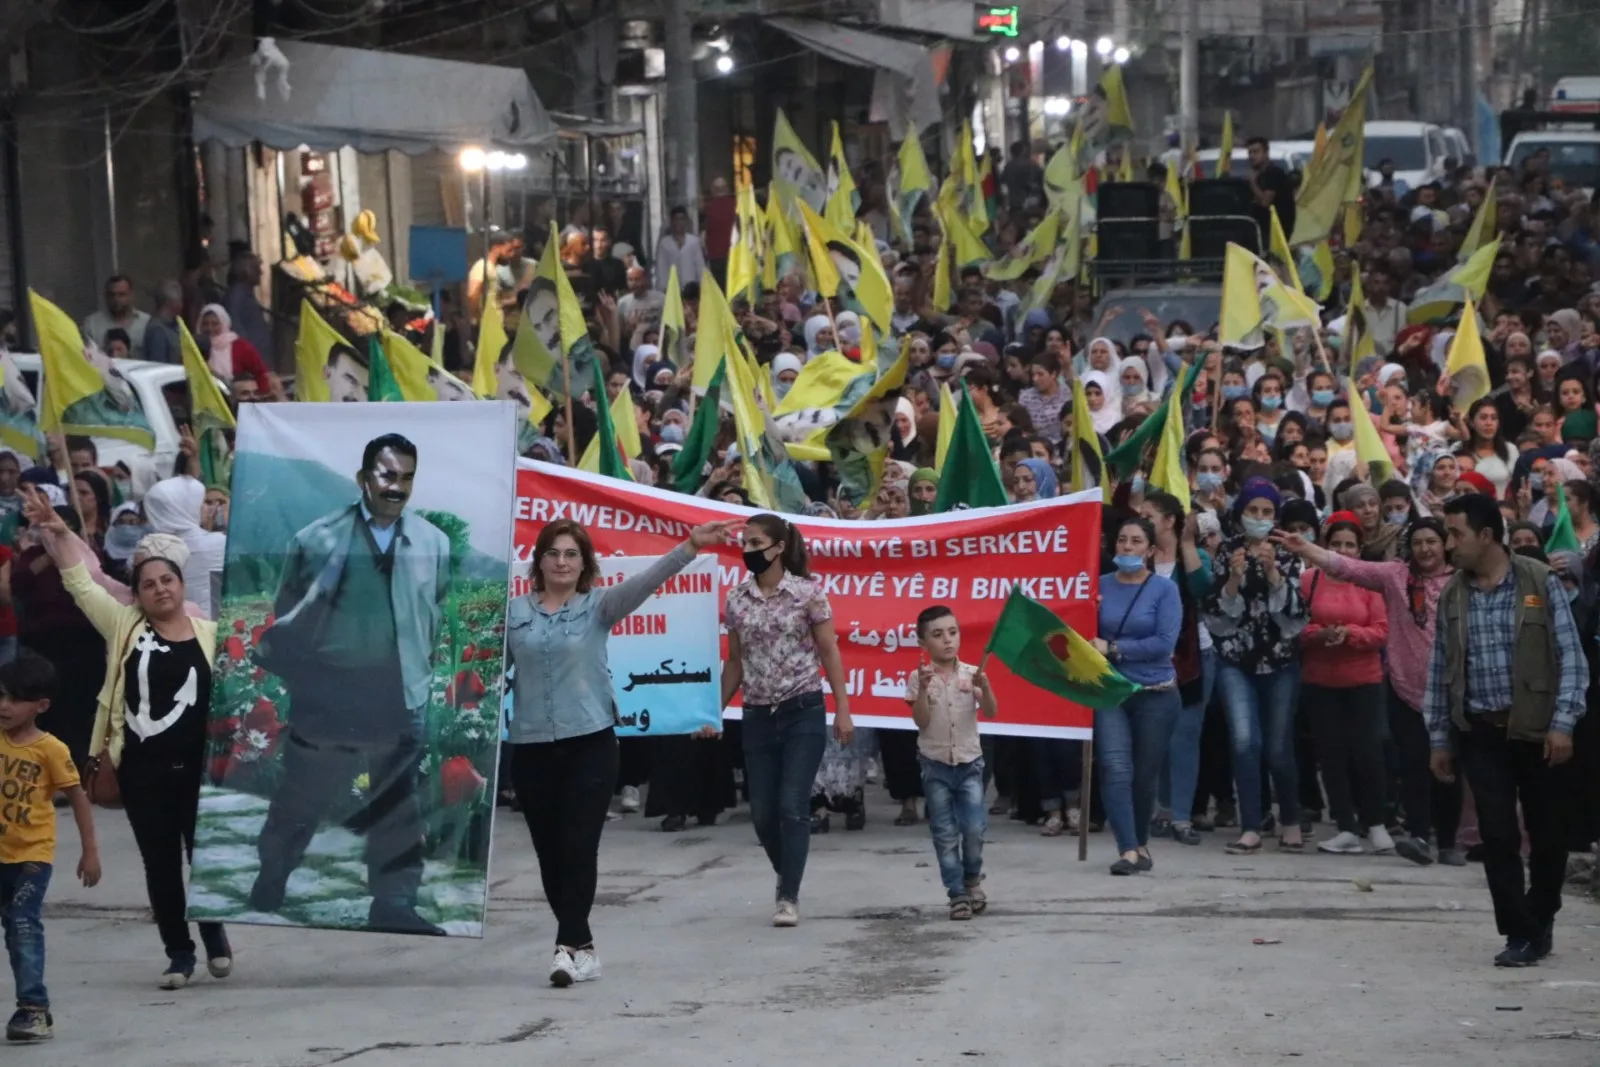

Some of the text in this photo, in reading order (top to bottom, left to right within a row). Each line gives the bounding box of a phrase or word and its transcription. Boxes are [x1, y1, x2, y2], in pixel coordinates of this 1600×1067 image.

[868, 536, 903, 558] YÊ
[911, 539, 937, 558] BI
[945, 525, 1068, 557] SERKEVÊ
[892, 573, 925, 598] YÊ
[931, 577, 959, 599] BI
[971, 571, 1090, 600] BINKEVÊ
[611, 614, 667, 636] BIBIN
[848, 620, 919, 653] قاومة
